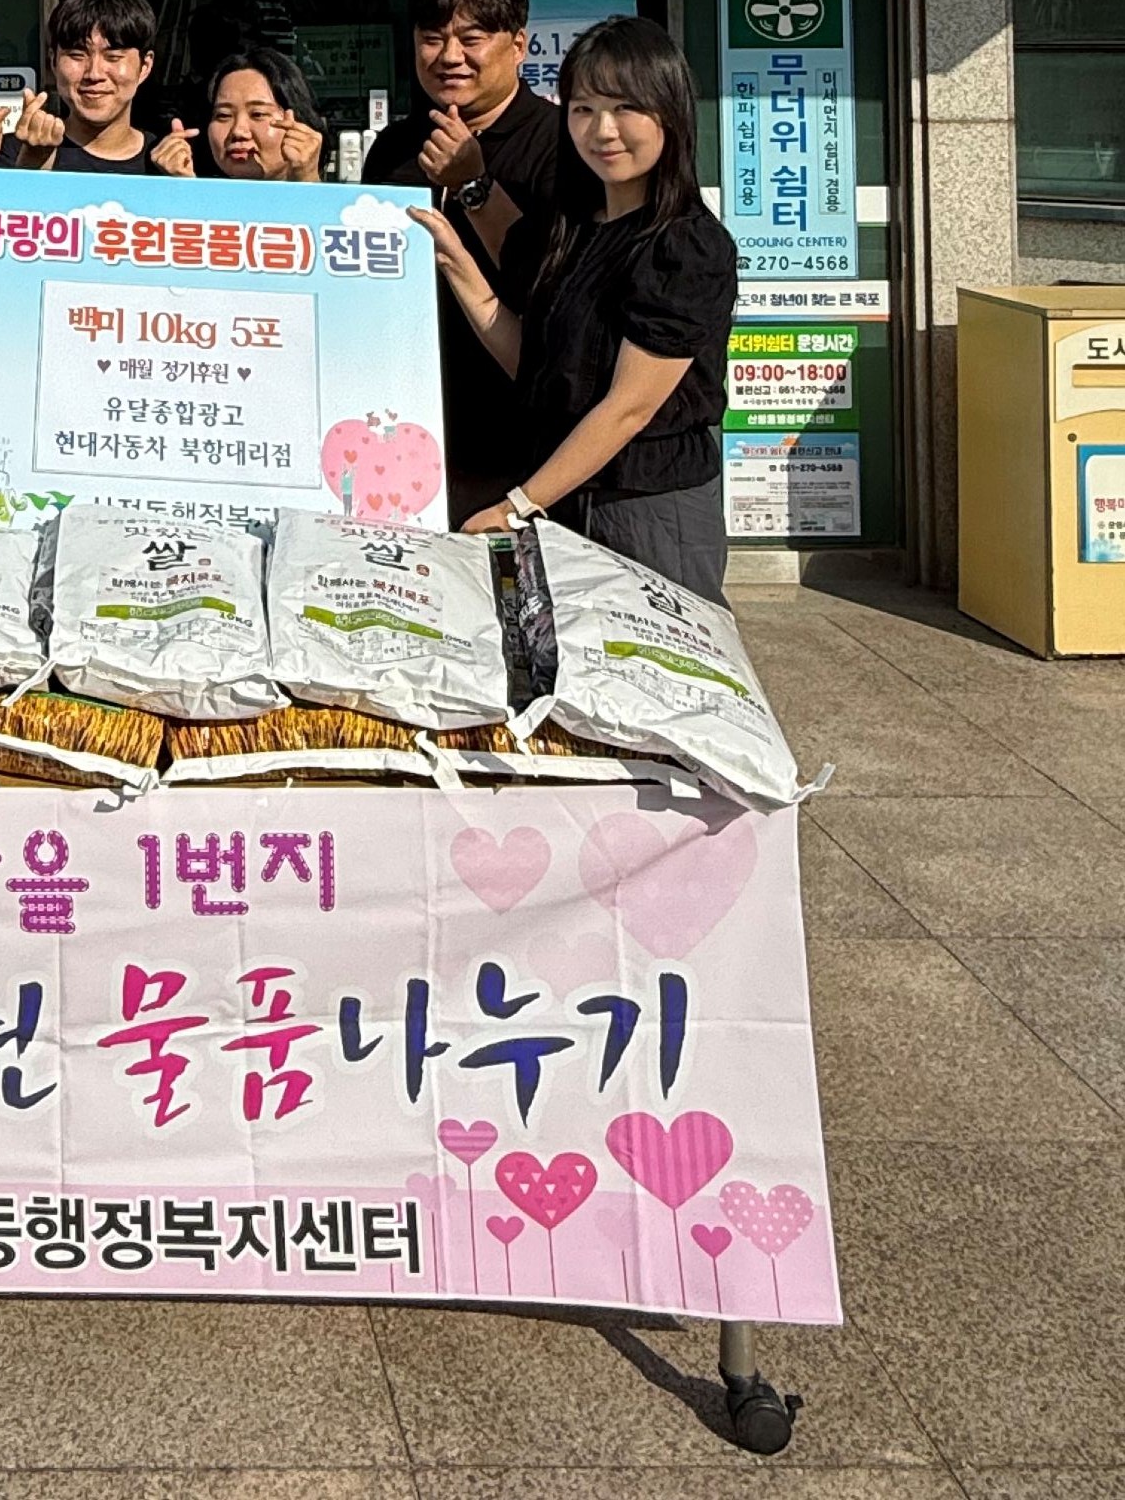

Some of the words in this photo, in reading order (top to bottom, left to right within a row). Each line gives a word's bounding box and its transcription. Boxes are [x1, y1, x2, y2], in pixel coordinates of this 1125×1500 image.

[739, 168, 758, 207] 겸용
[93, 216, 315, 274] 후원물품(금)
[323, 228, 405, 276] 전달
[798, 236, 848, 249] CENTER)
[756, 256, 849, 271] 270-4568
[769, 293, 808, 307] 청년이
[811, 294, 836, 307] 찾는
[840, 293, 852, 306] 큰
[854, 293, 881, 306] 목포
[69, 306, 124, 344] 백미
[136, 312, 217, 350] 10kg
[230, 316, 284, 350] 5포
[796, 333, 854, 353] 운영시간
[118, 357, 153, 381] 매월
[161, 360, 230, 385] 정기후원
[733, 363, 847, 382] 09:00~18:00
[102, 397, 245, 427] 유달종합광고
[54, 429, 168, 462] 현대자동차
[179, 436, 293, 469] 북항대리점
[141, 540, 198, 571] 쌀
[360, 542, 416, 572] 쌀
[136, 829, 336, 917] 1번지
